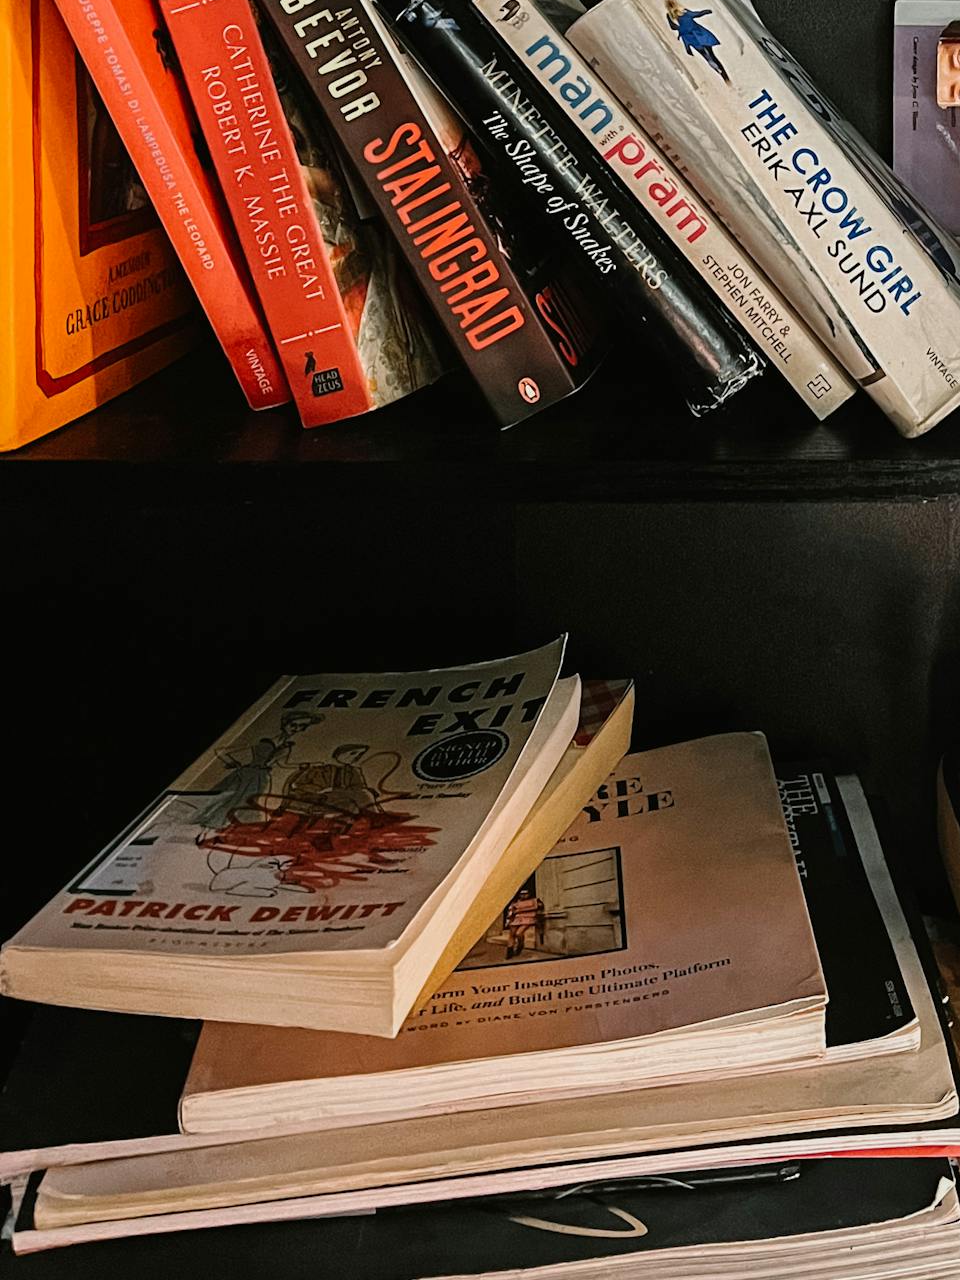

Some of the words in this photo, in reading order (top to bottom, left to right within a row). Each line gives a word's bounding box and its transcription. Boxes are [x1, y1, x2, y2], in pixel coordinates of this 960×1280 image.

[334, 7, 384, 70] ANTONY
[201, 65, 243, 160] ROBERT
[525, 34, 614, 137] man
[104, 41, 135, 97] TOMASI
[128, 97, 142, 115] DI
[135, 116, 175, 190] LAMPEDUSA
[173, 189, 190, 214] THE
[182, 214, 215, 272] LEOPARD
[221, 23, 280, 165] CATHERINE
[267, 166, 298, 220] THE
[286, 224, 327, 302] GREAT
[478, 57, 583, 177] MINETTE
[575, 173, 670, 293] WALTERS
[598, 128, 619, 148] with
[235, 165, 256, 190] K.
[481, 108, 510, 144] The
[505, 139, 554, 201] Shape
[545, 191, 568, 216] of
[563, 206, 618, 276] Snakes
[602, 132, 710, 245] pram
[747, 88, 799, 147] THE
[792, 147, 873, 242] CROW
[865, 243, 923, 317] GIRL
[244, 195, 287, 282] MASSIE
[363, 122, 526, 353] STALINGRAD
[741, 122, 793, 183] ERIK
[784, 183, 833, 240] AXL
[826, 238, 888, 317] SUND
[65, 295, 110, 336] GRACE
[702, 253, 749, 311] STEPHEN
[744, 305, 793, 365] MITCHELL
[727, 261, 752, 288] JON
[750, 284, 783, 327] FARRY
[778, 323, 792, 338] &
[244, 347, 274, 397] VINTAGE
[925, 346, 960, 389] VINTAGE
[283, 673, 525, 709] FRENCH
[407, 696, 547, 736] EXIT
[63, 898, 240, 923] PATRICK
[249, 901, 406, 922] DEWITT
[431, 1003, 468, 1017] Life,
[472, 997, 505, 1009] and
[509, 991, 553, 1006] Build
[557, 987, 585, 1000] the
[588, 977, 659, 996] Ultimate
[663, 956, 733, 981] Platform
[470, 981, 511, 995] Your
[514, 972, 596, 993] Instagram
[599, 963, 660, 982] Photos,
[477, 1012, 522, 1024] DIANE
[529, 1008, 558, 1019] VON
